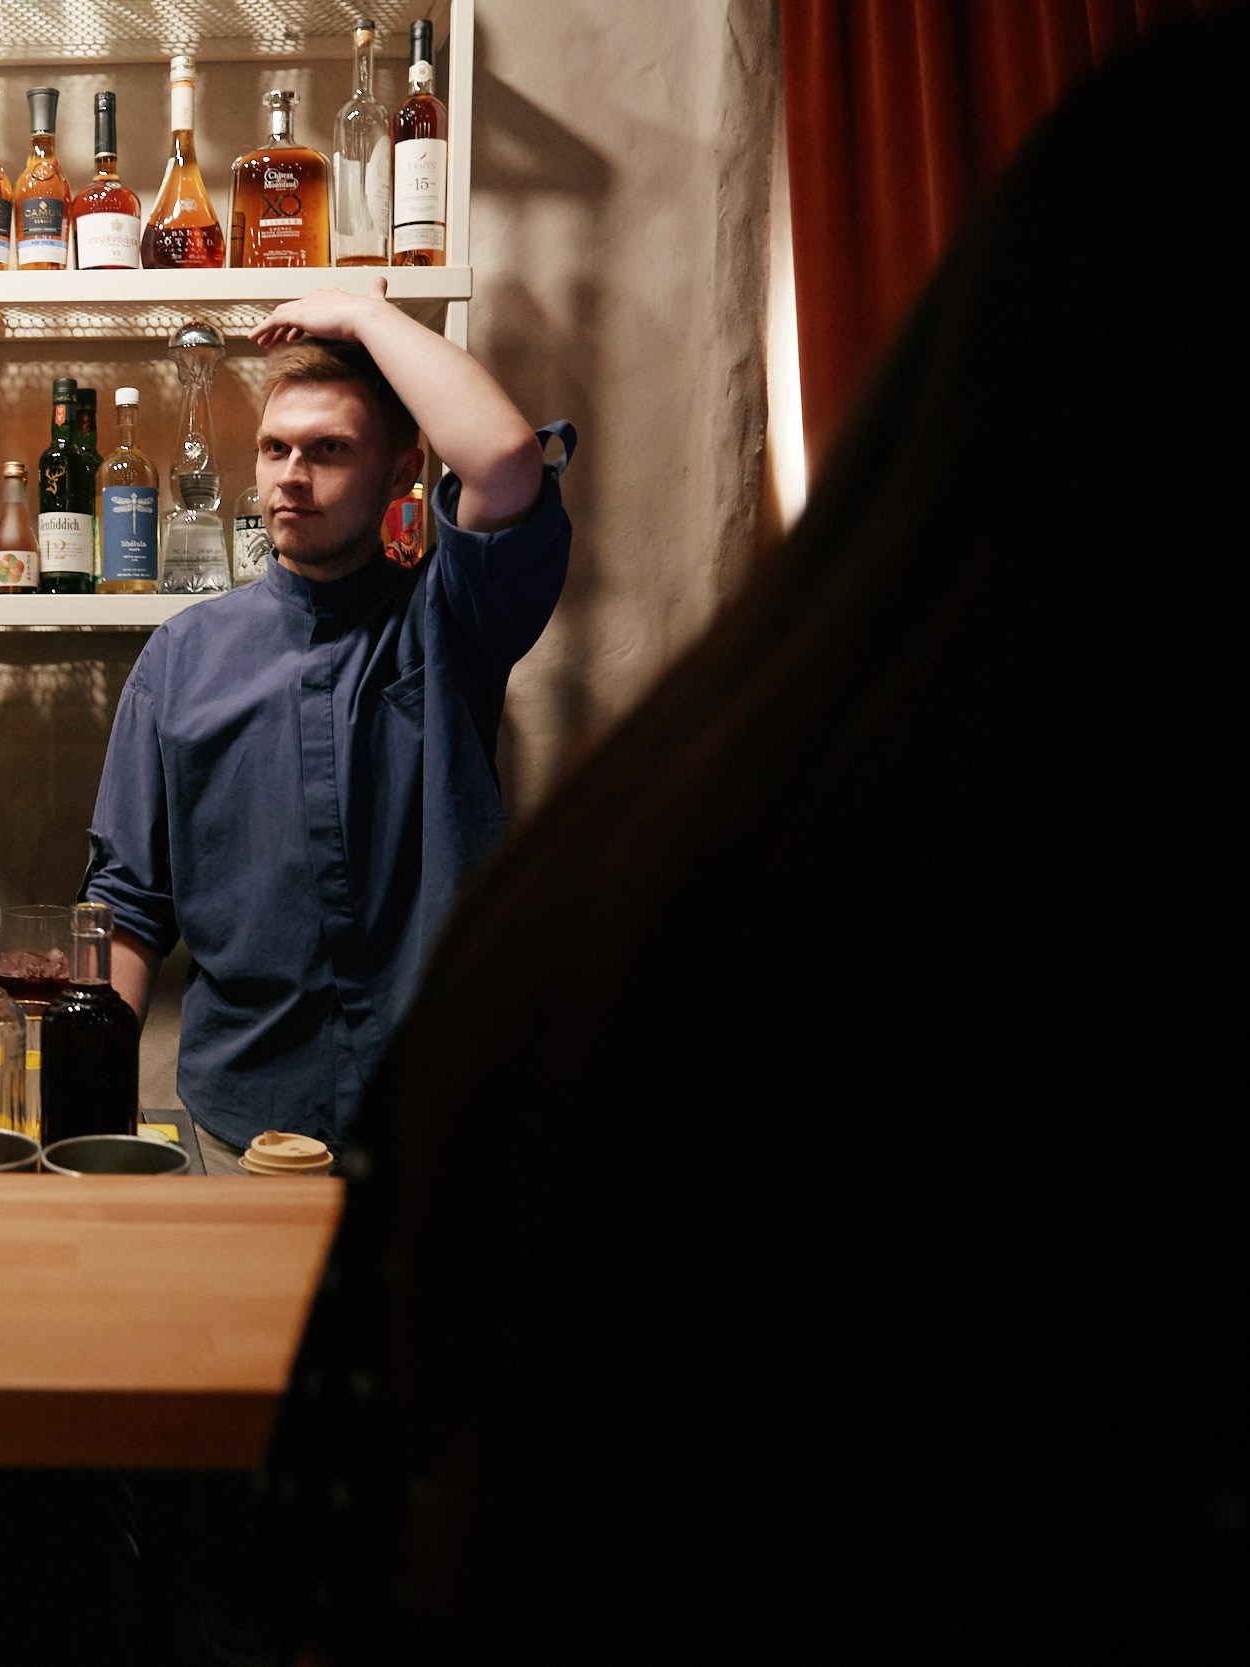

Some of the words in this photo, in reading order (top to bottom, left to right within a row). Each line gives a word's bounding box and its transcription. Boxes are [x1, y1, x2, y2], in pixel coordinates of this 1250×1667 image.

[415, 178, 429, 190] 15
[261, 194, 302, 217] XO
[88, 236, 138, 247] COURVOISIER
